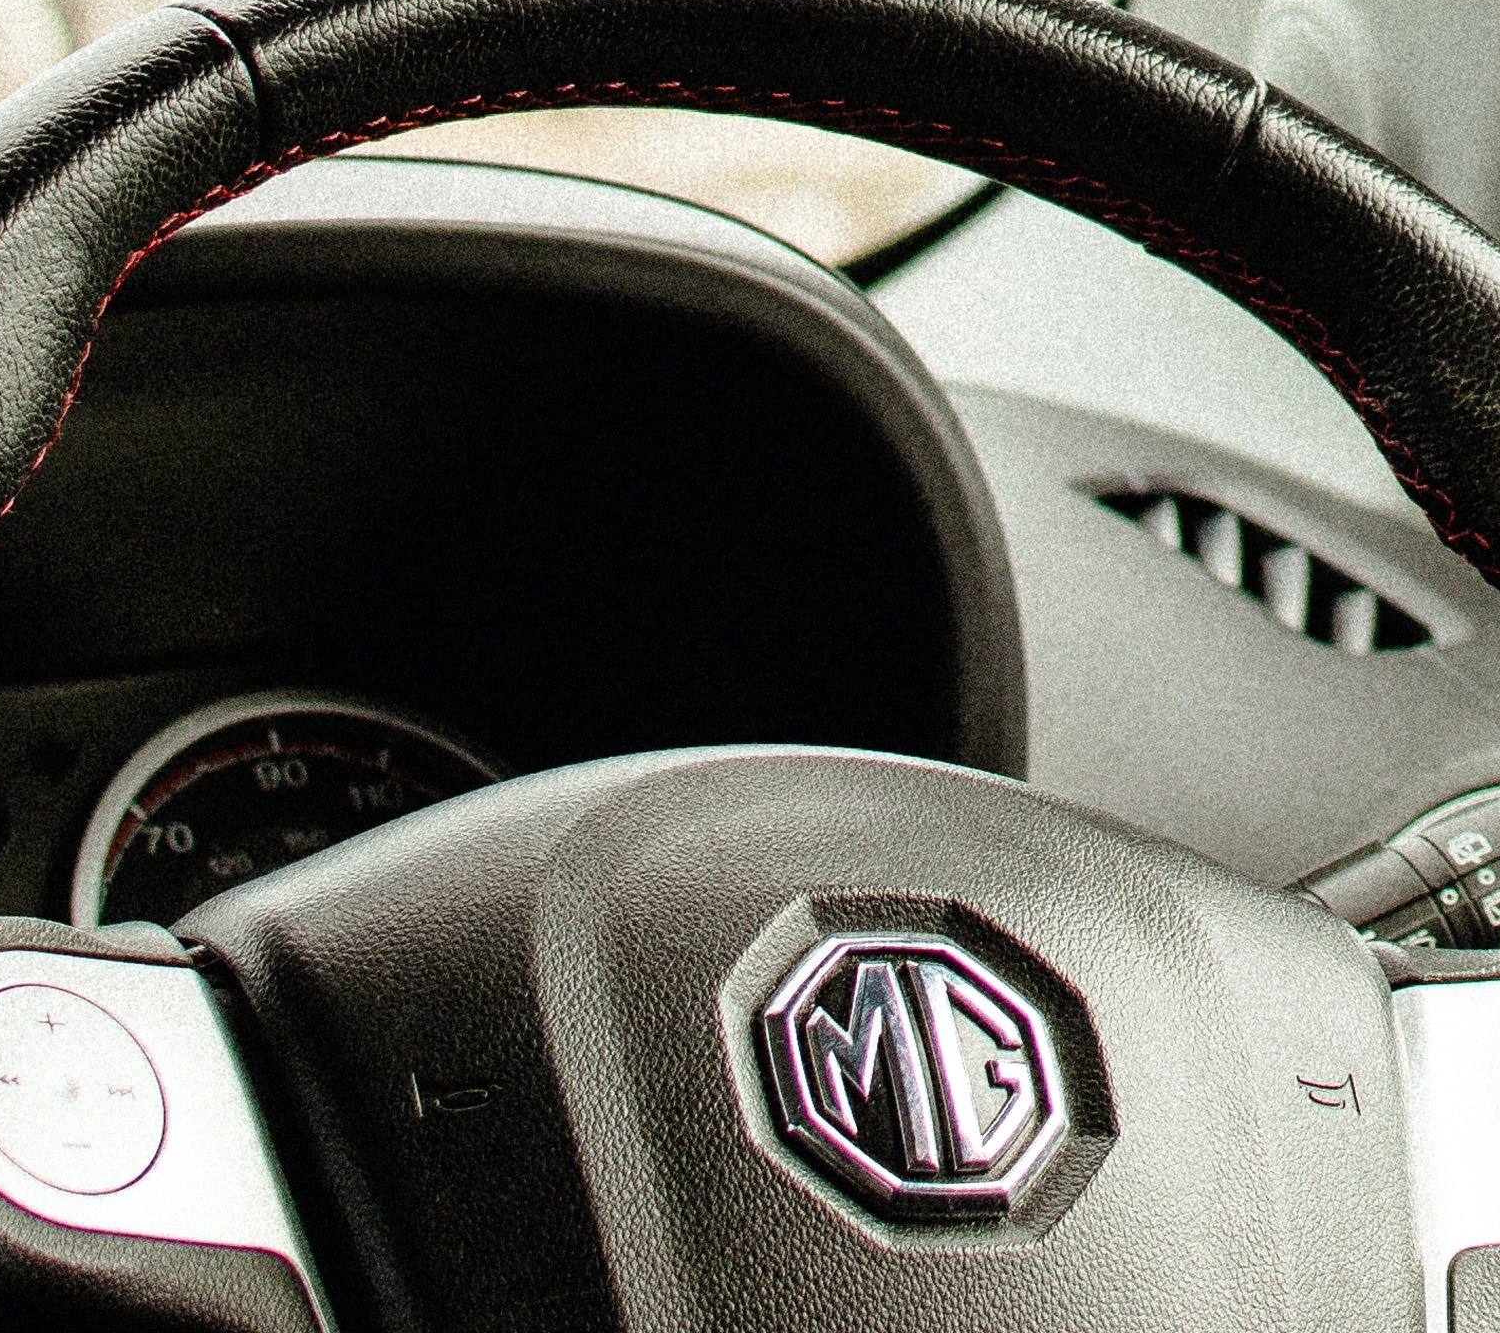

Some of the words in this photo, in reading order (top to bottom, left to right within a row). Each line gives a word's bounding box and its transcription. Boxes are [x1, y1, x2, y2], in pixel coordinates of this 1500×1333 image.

[254, 759, 309, 791] 90
[347, 780, 403, 811] 110
[142, 821, 195, 855] 70
[805, 961, 1035, 1174] MG
